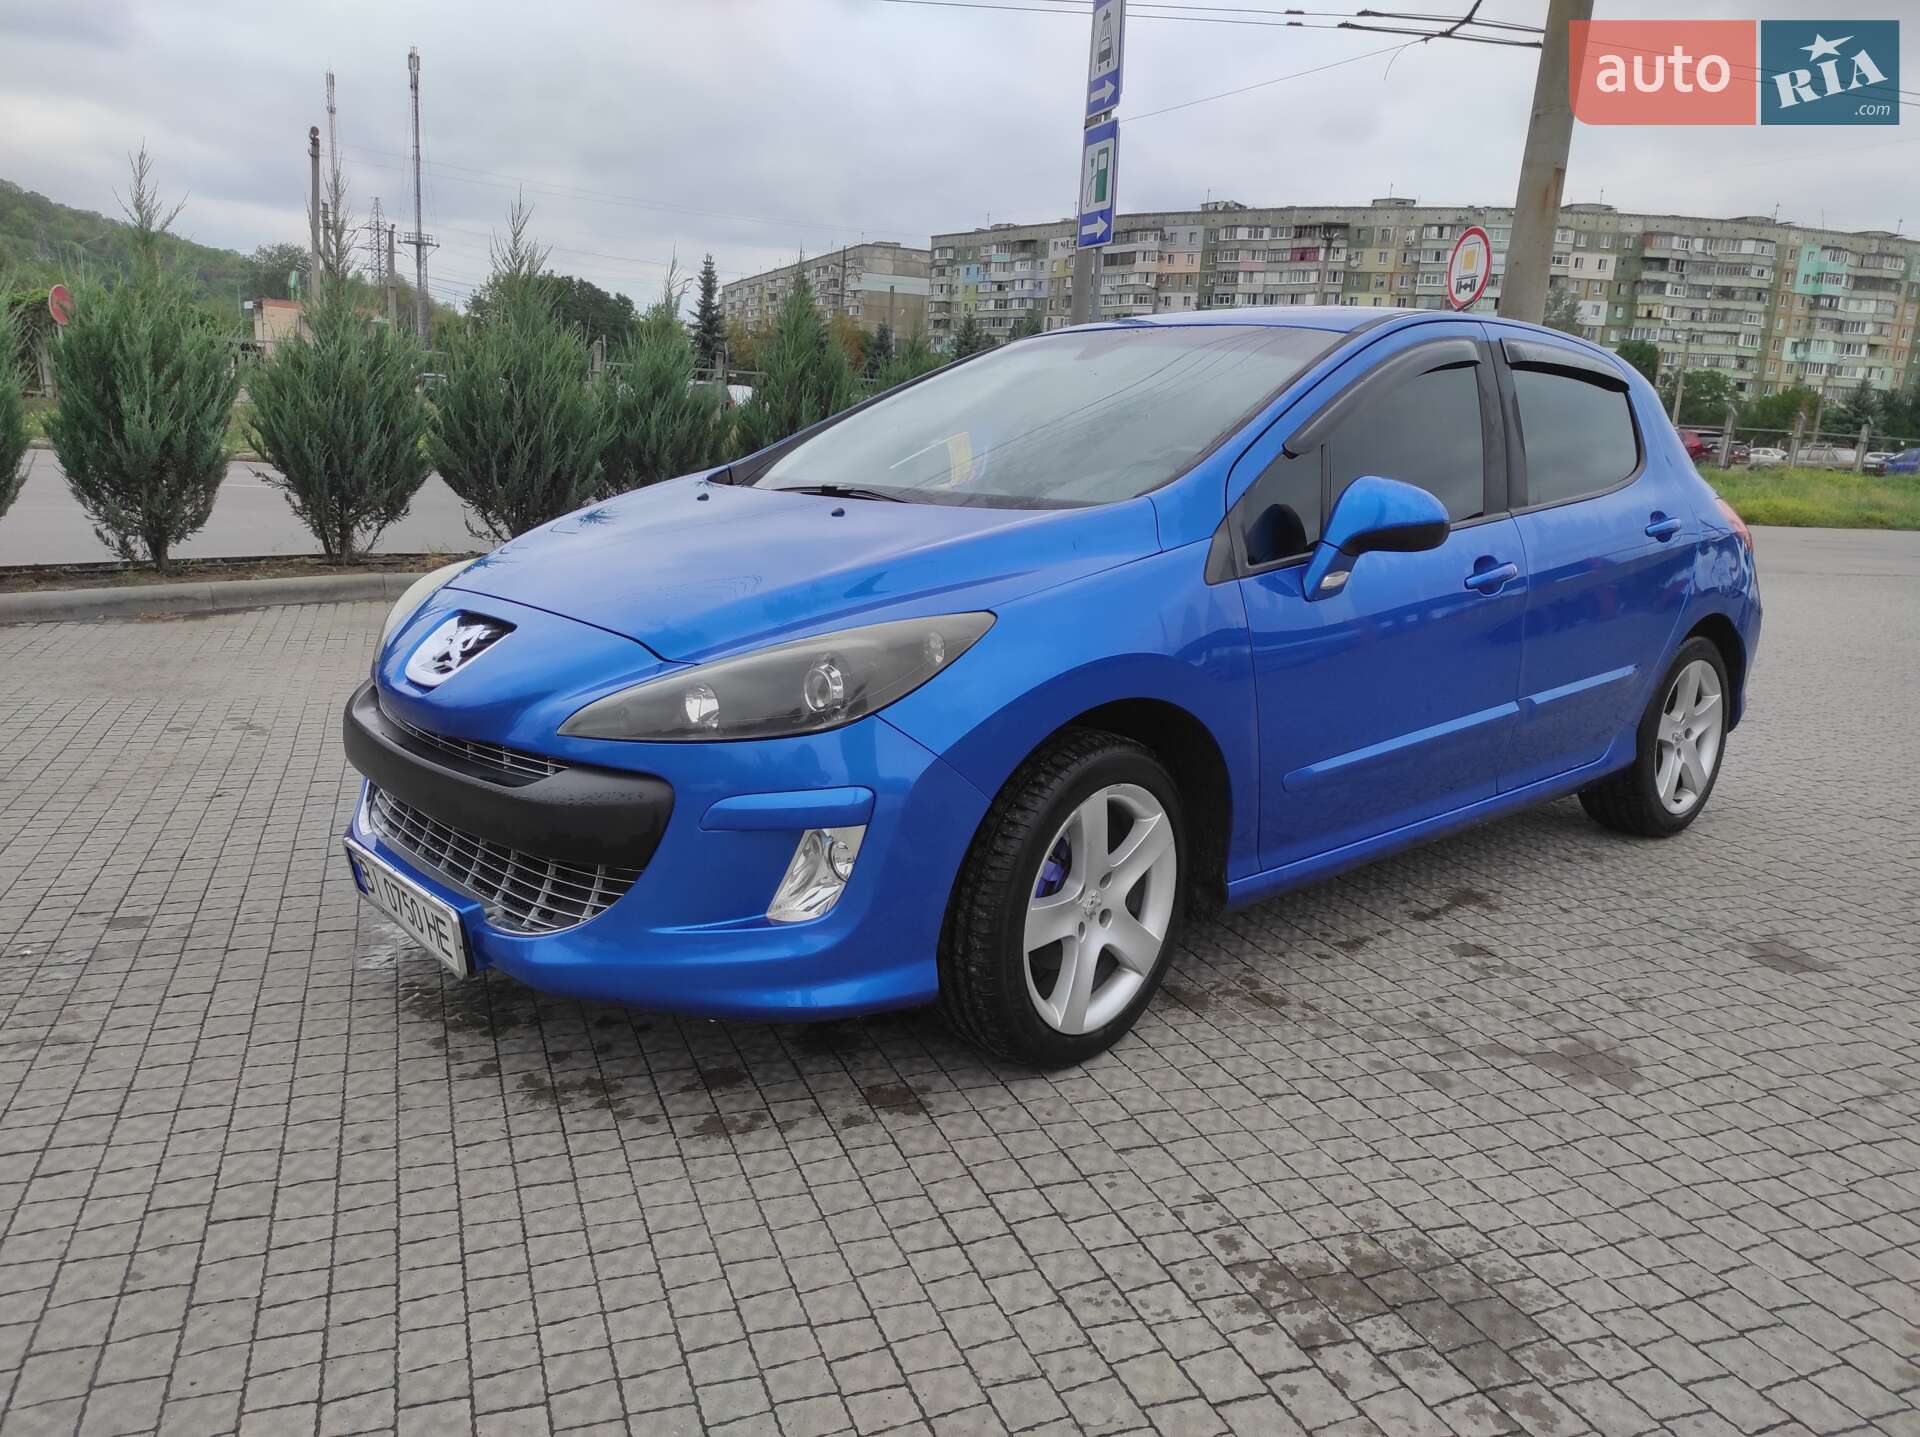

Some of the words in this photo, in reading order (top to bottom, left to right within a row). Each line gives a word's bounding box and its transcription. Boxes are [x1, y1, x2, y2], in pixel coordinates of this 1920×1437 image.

[359, 857, 384, 902] BI
[384, 877, 425, 935] 0750
[423, 906, 453, 959] HE
